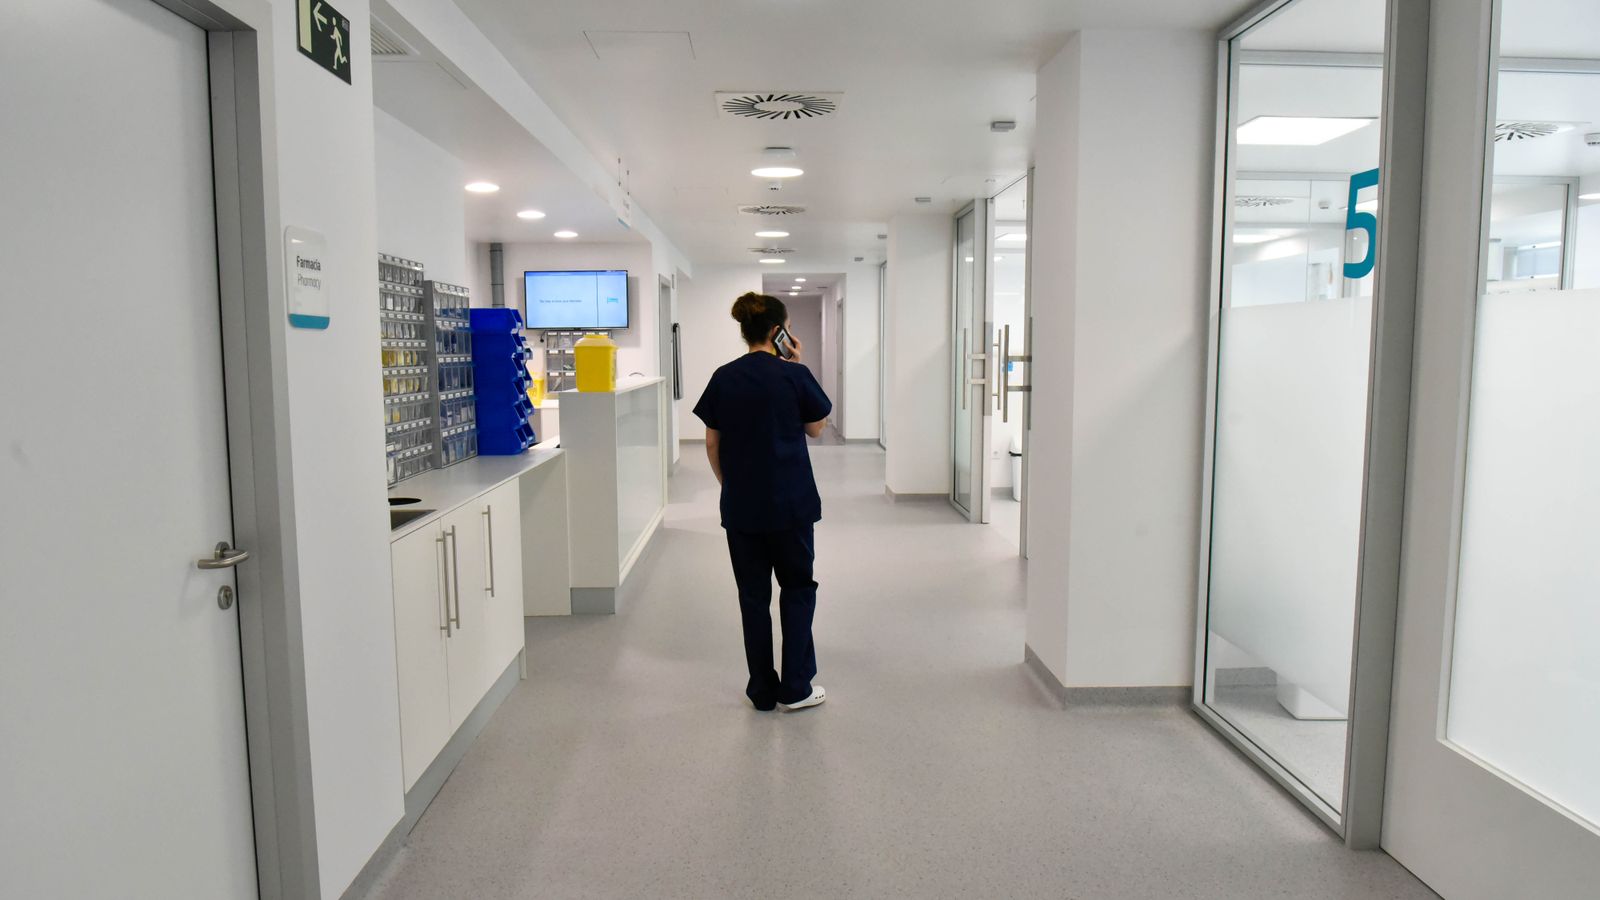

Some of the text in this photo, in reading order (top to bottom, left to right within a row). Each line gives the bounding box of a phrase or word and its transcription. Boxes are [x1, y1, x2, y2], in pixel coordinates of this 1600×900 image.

[1343, 168, 1379, 278] 5
[296, 255, 321, 271] Farmacia
[298, 273, 321, 290] Pharmacy
